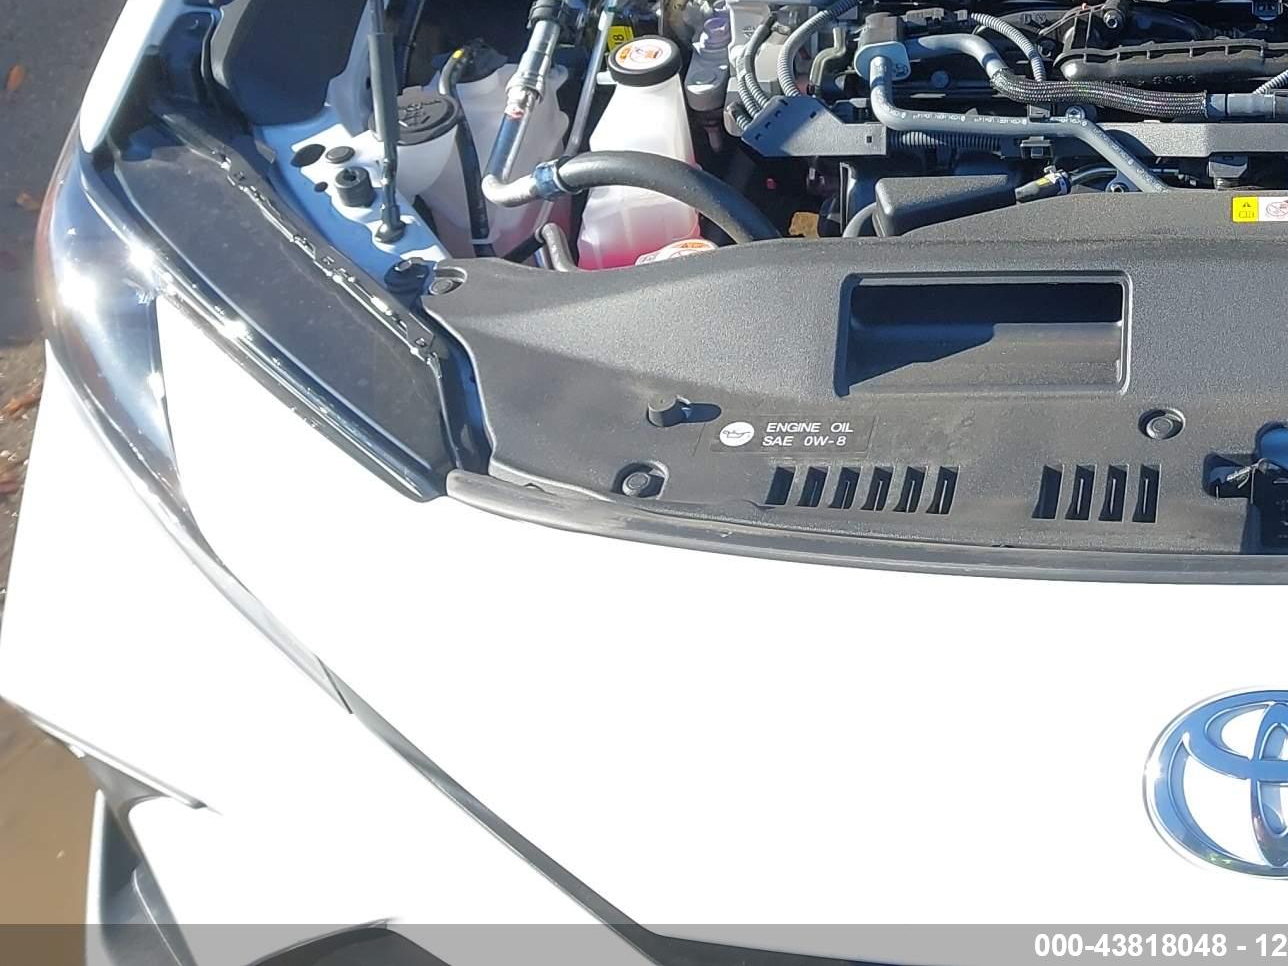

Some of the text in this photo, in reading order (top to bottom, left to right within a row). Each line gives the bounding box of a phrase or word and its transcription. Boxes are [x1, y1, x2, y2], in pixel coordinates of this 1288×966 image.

[766, 422, 854, 433] ENGINE OIL
[762, 435, 847, 447] SAE 0W-8
